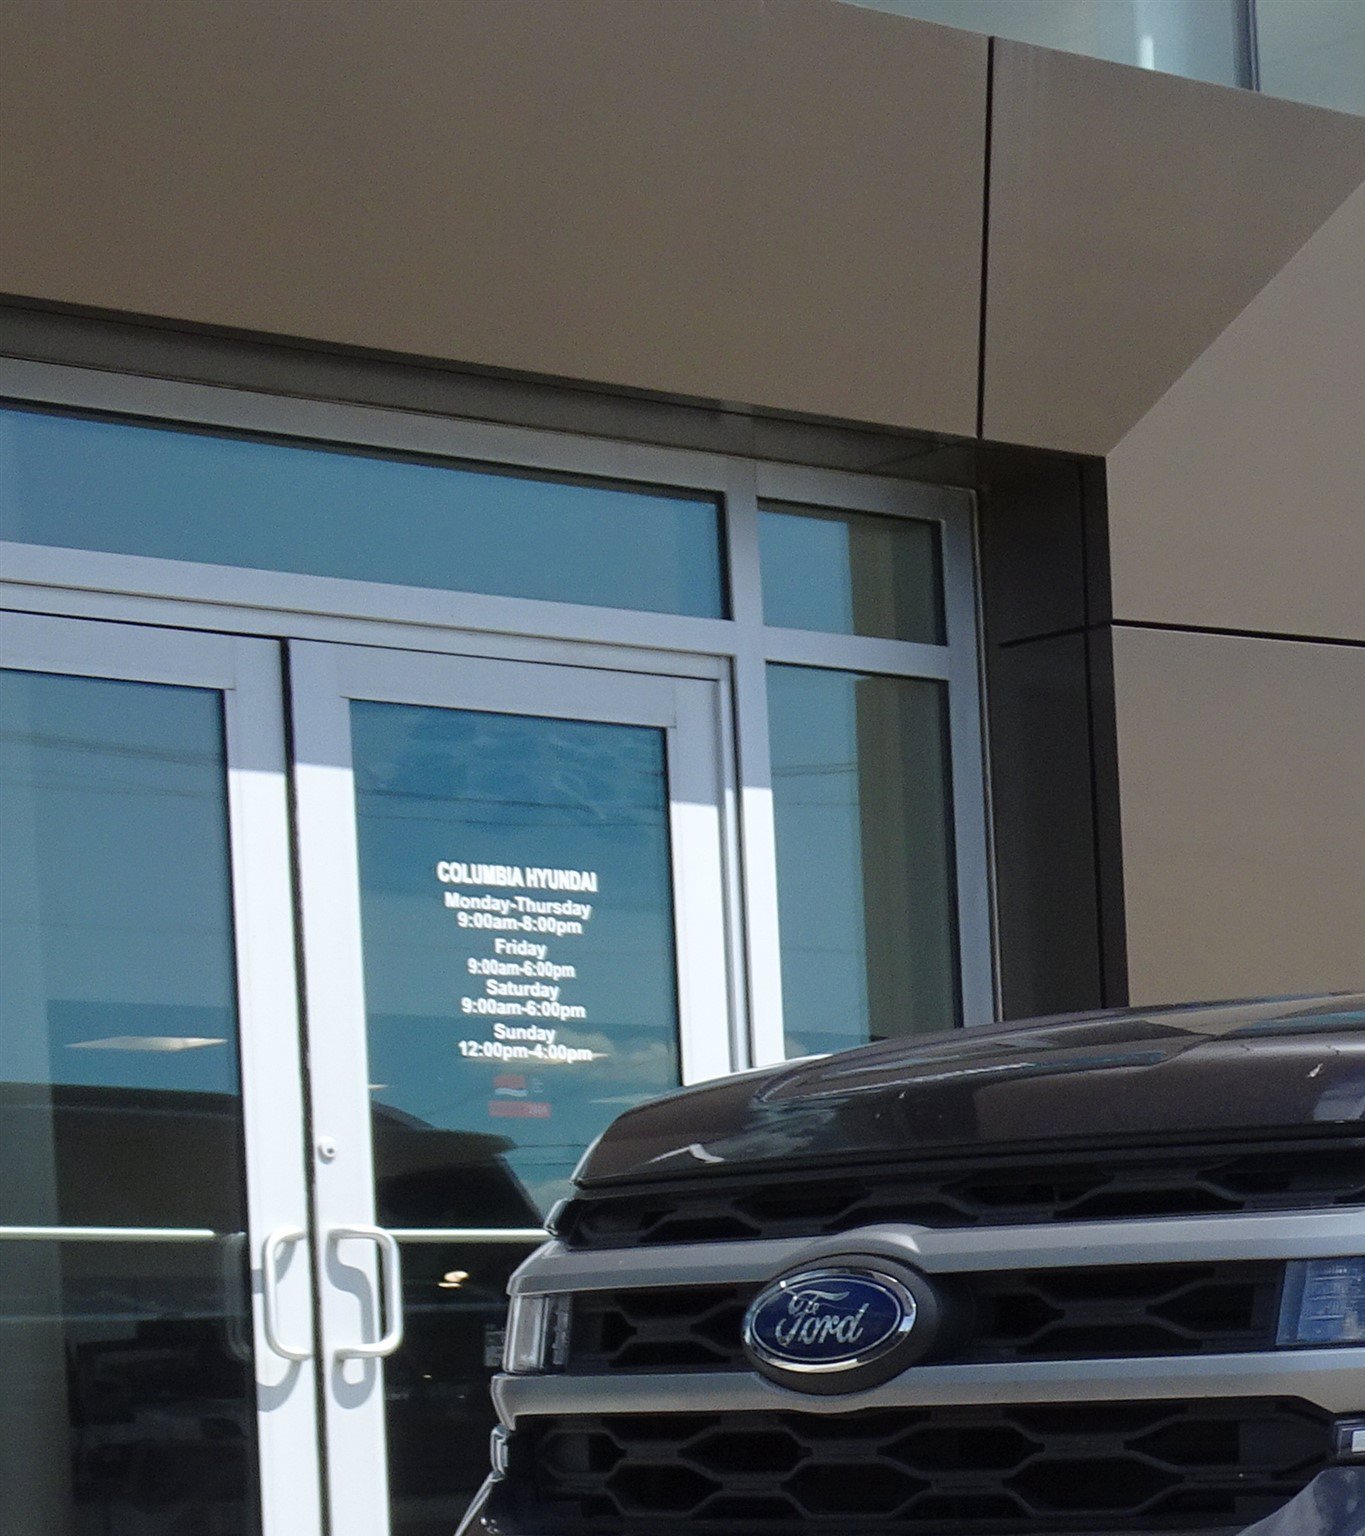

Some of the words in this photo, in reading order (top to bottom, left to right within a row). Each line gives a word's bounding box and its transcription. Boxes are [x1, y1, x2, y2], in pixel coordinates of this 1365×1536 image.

[437, 861, 525, 888] COLUMBIA
[525, 867, 598, 892] HYUNDAI
[444, 891, 592, 920] Monday-Thursday
[457, 911, 582, 936] 9:00am-8:00pm
[494, 938, 548, 960] Friday
[467, 957, 576, 980] 9:00am-6:00pm
[486, 979, 560, 1001] Saturday
[461, 997, 587, 1020] 9:00am-6:00pm
[493, 1023, 556, 1044] Sunday
[458, 1040, 593, 1063] 12:00pm-4:00pm
[775, 1289, 871, 1348] Ford
